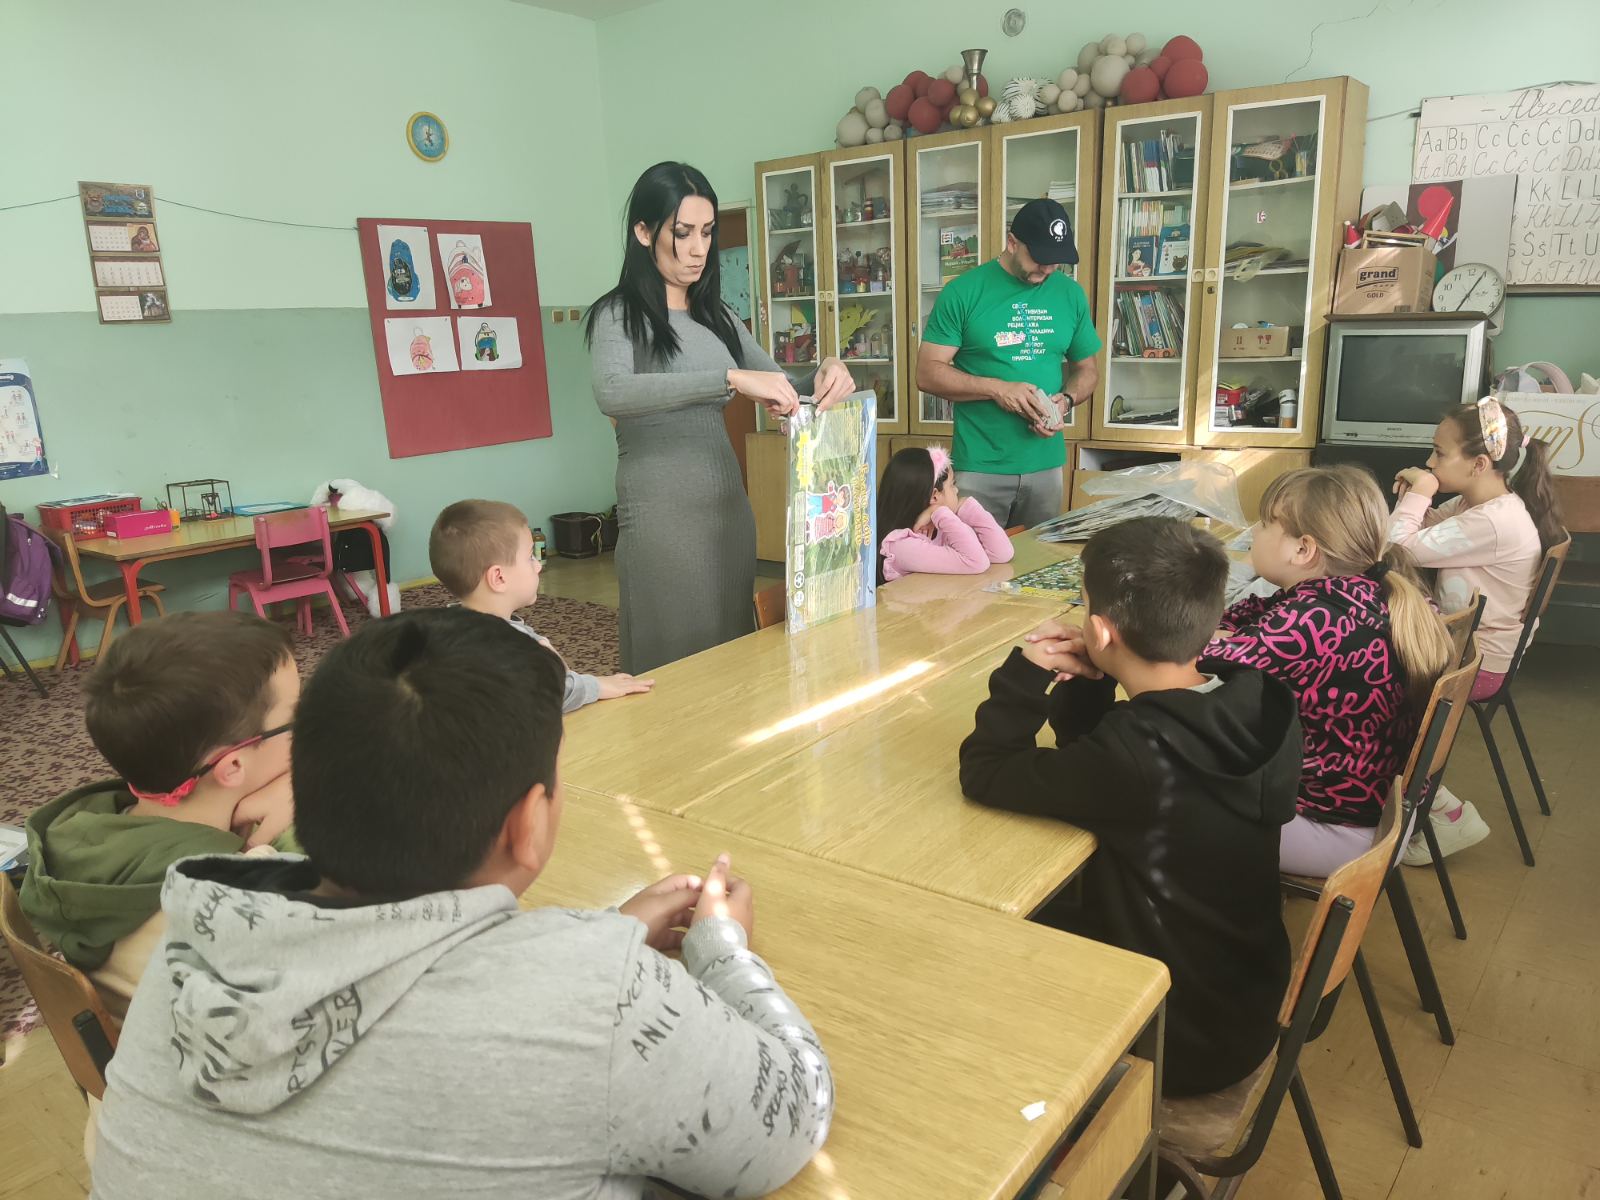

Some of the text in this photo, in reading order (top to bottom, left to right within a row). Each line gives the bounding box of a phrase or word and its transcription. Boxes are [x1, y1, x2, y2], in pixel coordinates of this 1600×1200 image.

[1359, 269, 1396, 281] grand
[1467, 268, 1477, 277] 12
[1443, 283, 1453, 291] 10
